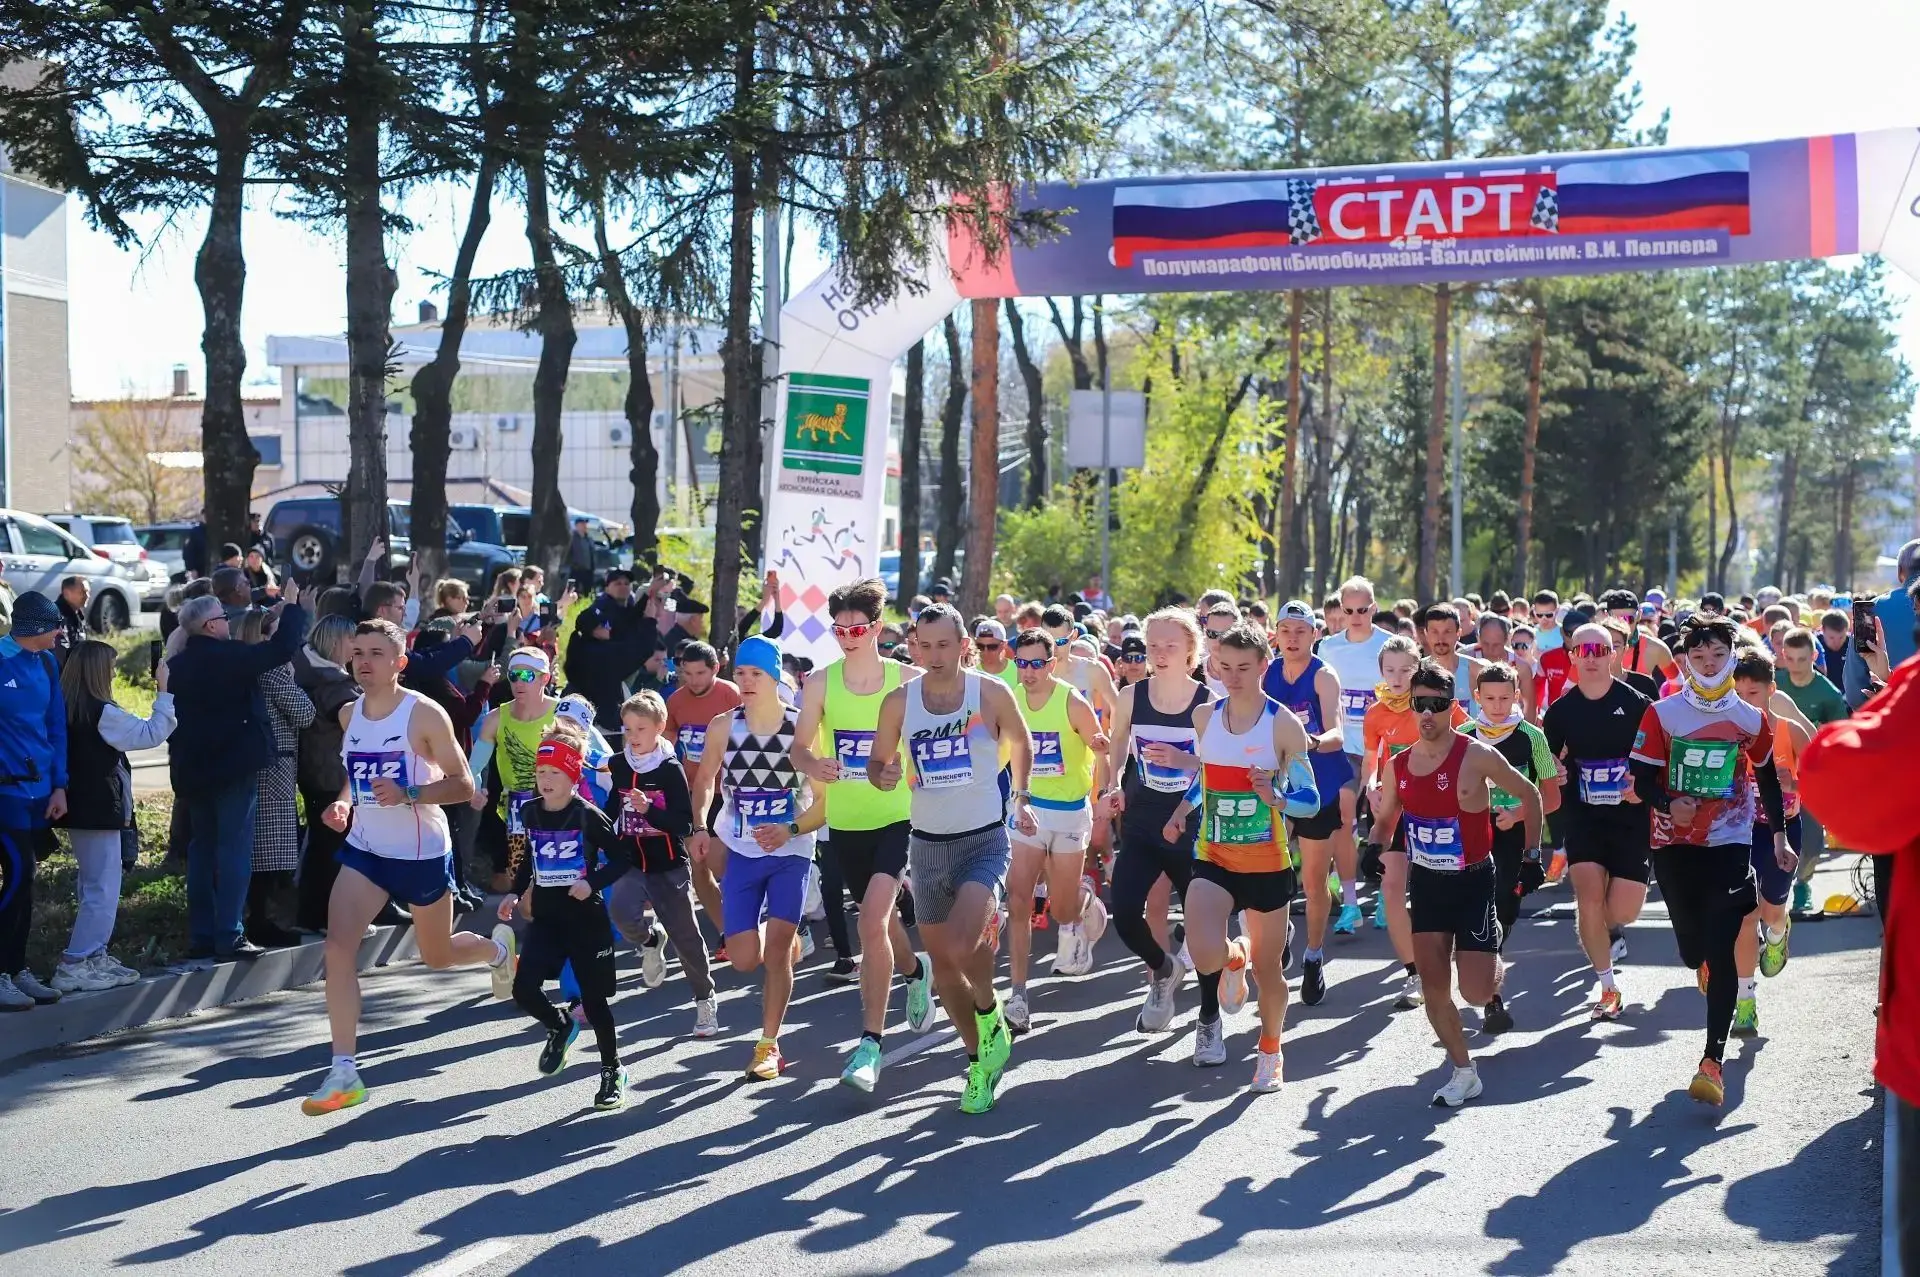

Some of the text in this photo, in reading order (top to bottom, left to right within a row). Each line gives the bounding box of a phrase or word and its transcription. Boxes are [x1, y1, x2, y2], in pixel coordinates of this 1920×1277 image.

[1328, 184, 1524, 240] СТАРТ
[1143, 254, 1283, 276] Полумарафон
[1585, 241, 1621, 259] В.И.
[1625, 238, 1718, 257] Пеллера
[916, 737, 969, 760] 191
[1683, 748, 1728, 769] 86
[353, 761, 401, 779] 212
[931, 771, 972, 781] ТРАНСНЕФТЬ
[739, 798, 788, 816] 312
[1216, 798, 1258, 817] 89
[1408, 822, 1455, 845] 168
